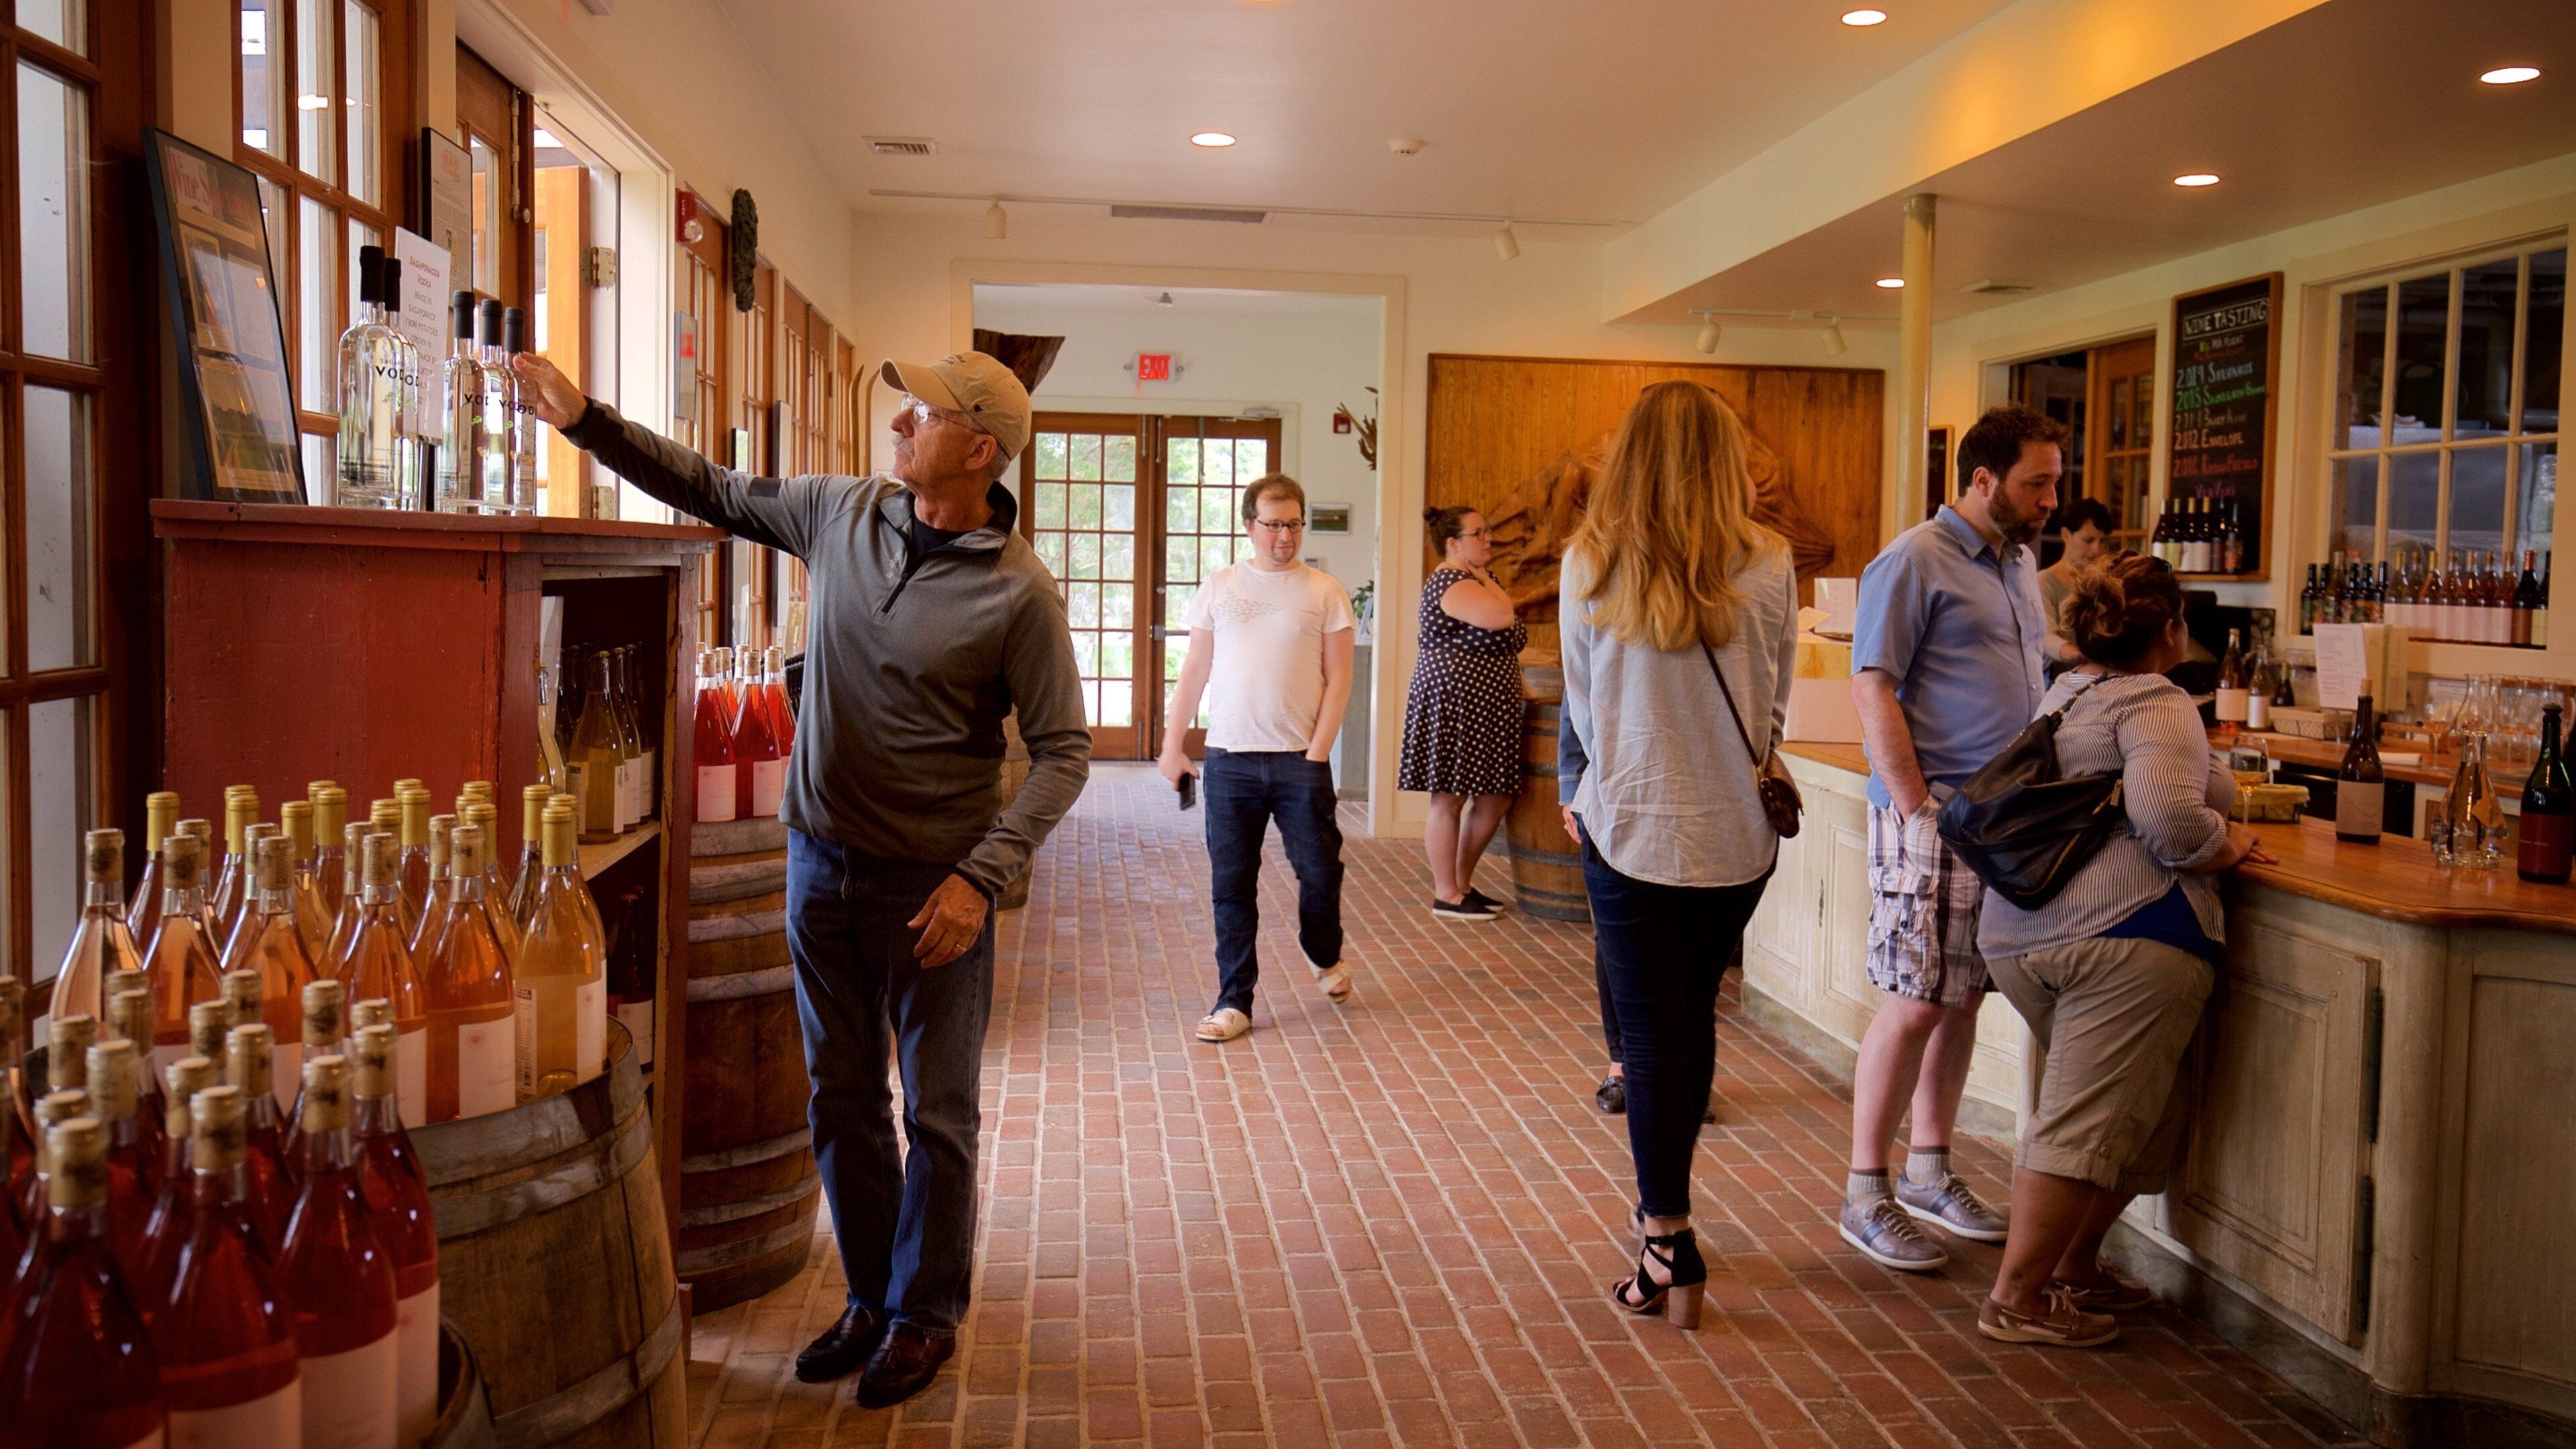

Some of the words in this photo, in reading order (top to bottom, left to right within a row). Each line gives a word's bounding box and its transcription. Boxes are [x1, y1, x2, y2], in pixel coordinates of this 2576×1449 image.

[415, 290, 427, 303] MADE
[405, 318, 417, 328] FROM
[418, 323, 438, 337] POTATOES
[2185, 315, 2212, 334] WINE
[2214, 301, 2267, 329] TASTING
[1139, 354, 1170, 380] EXIT
